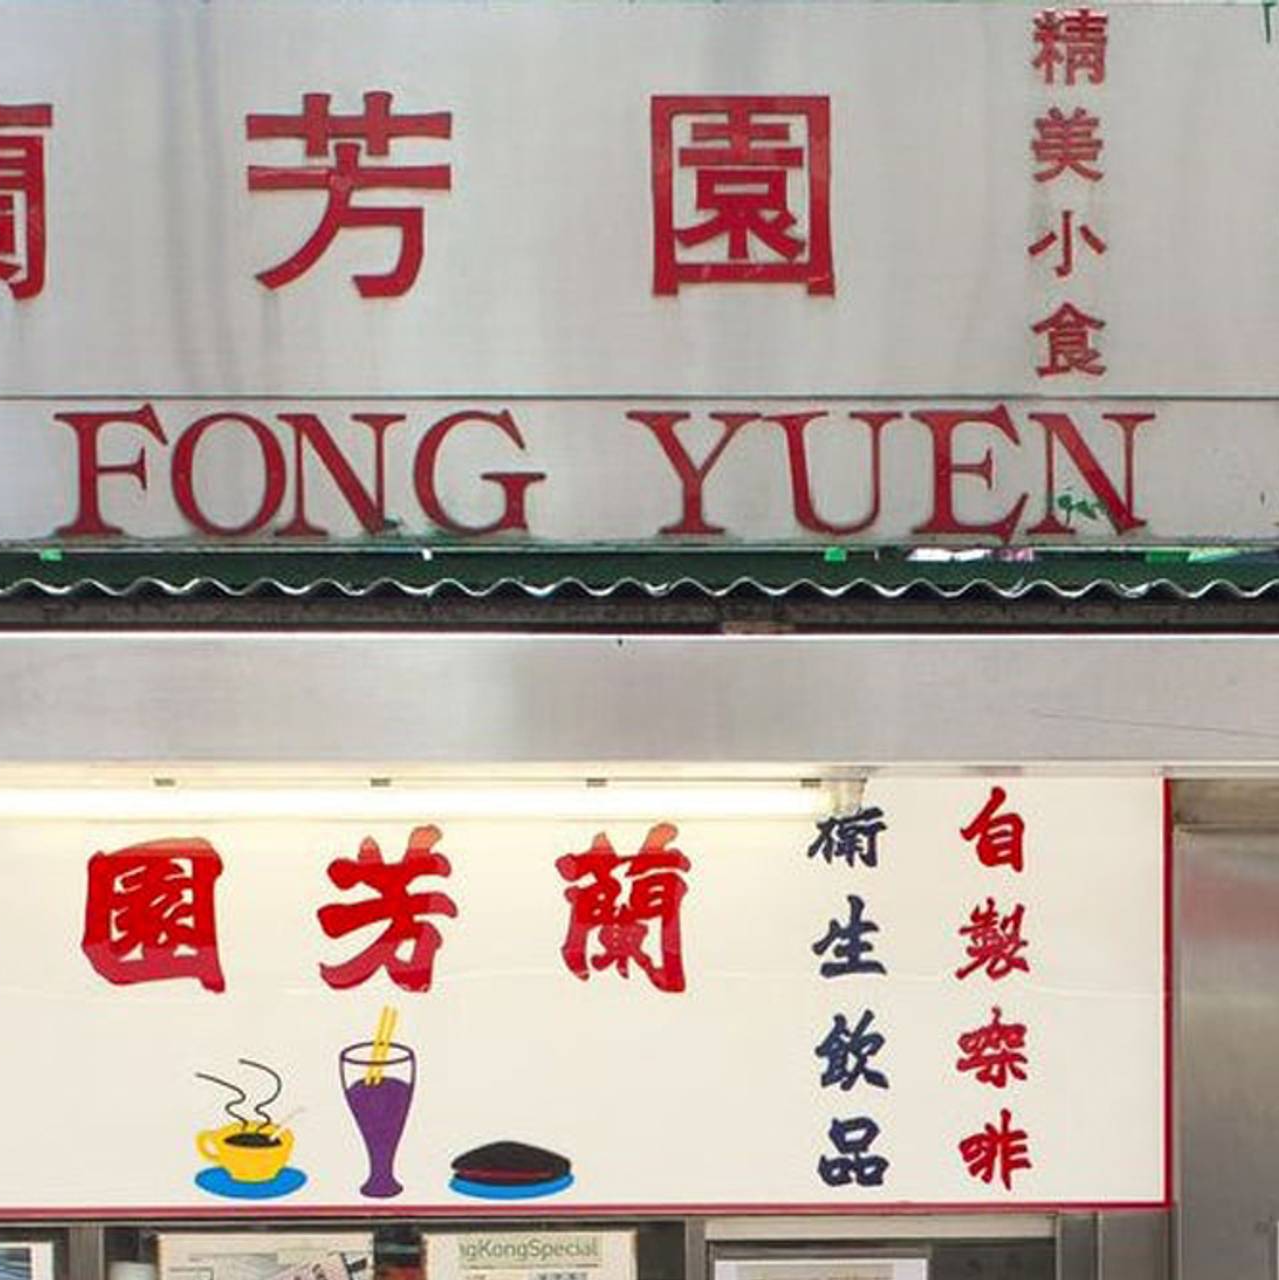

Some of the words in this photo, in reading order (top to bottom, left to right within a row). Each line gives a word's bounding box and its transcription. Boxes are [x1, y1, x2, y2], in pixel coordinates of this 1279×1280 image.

[1029, 6, 1108, 379] 精美小食
[53, 403, 546, 538] FONG
[626, 404, 1157, 544] YUEN
[807, 806, 890, 1190] 衛生飲品
